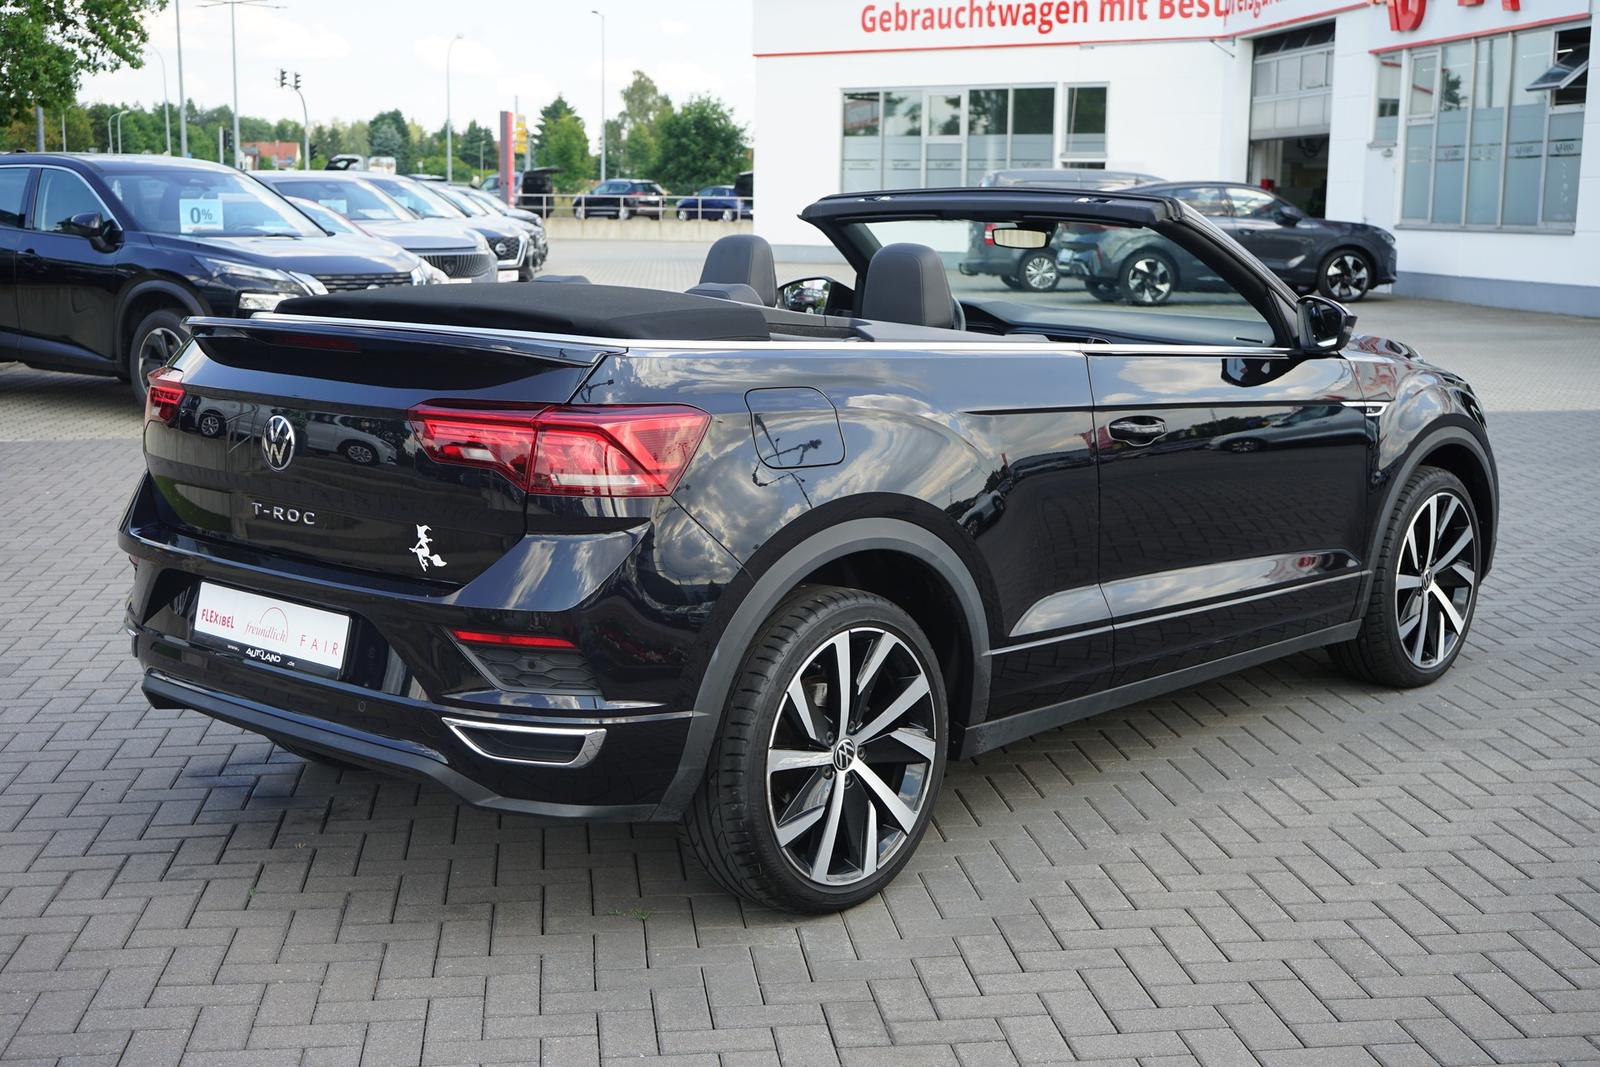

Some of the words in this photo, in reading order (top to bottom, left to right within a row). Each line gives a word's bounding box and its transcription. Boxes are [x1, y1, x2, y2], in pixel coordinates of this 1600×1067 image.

[861, 0, 1088, 34] Gebrauchtwagen
[1099, 0, 1147, 22] mit
[190, 207, 213, 224] 0%
[252, 502, 316, 526] T-ROC
[201, 608, 235, 629] FLEXIBEL
[245, 648, 281, 662] AUTOLAND
